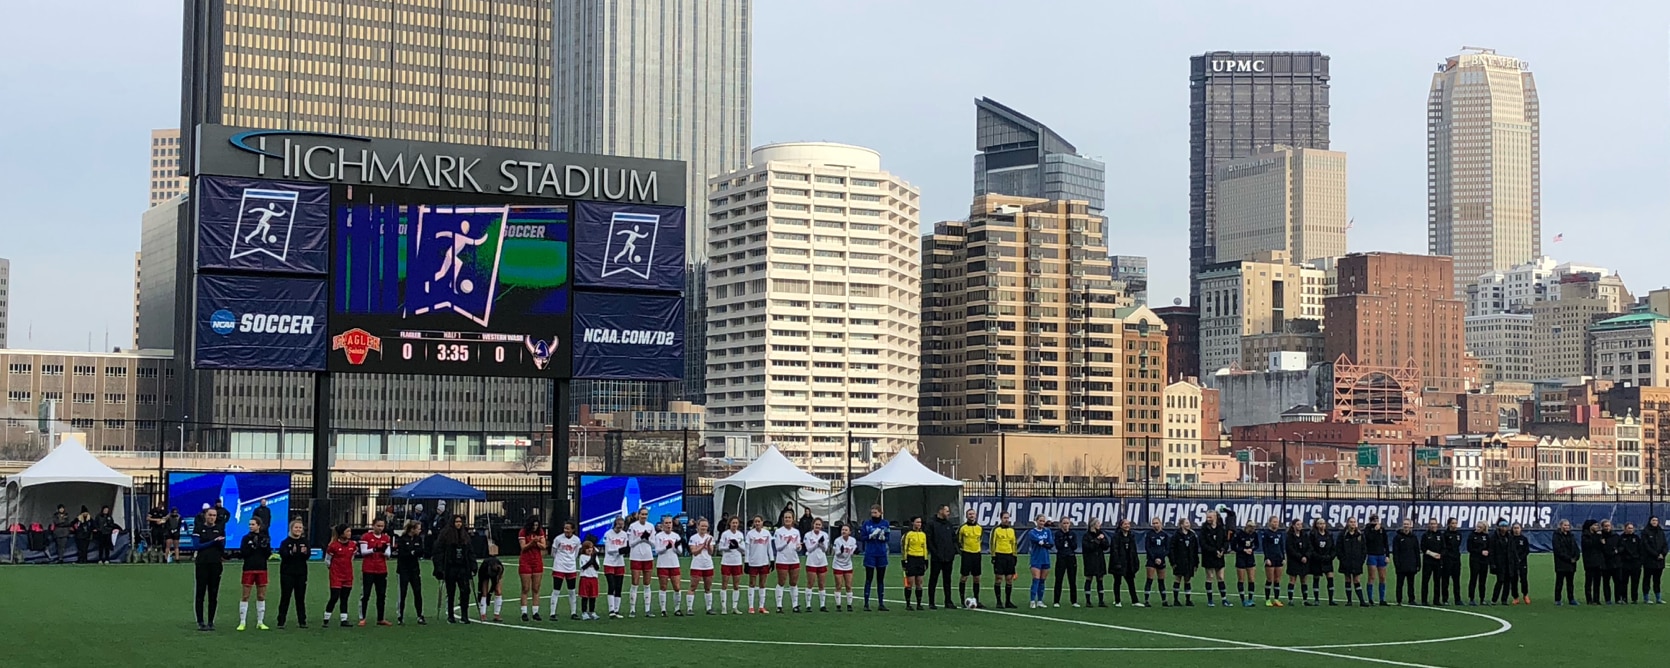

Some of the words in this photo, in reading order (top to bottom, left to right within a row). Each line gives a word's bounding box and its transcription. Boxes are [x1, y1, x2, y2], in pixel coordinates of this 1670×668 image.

[1210, 60, 1265, 72] UPMC
[258, 136, 483, 193] HIGHMARK
[499, 159, 659, 202] STADIUM
[212, 321, 236, 329] NCAA
[239, 313, 315, 334] SOCCER
[482, 333, 507, 341] WESTERN
[583, 328, 675, 345] NCAA.COM/D2
[402, 343, 413, 360] 0
[437, 344, 469, 362] 3:35
[495, 346, 505, 363] 0
[1028, 502, 1120, 527] DIVISION
[1148, 503, 1208, 527] MEN'S
[1232, 503, 1323, 528] WOMEN'S
[1328, 504, 1400, 528] SOCCER
[1406, 504, 1552, 529] CHAMPIONSHIPS
